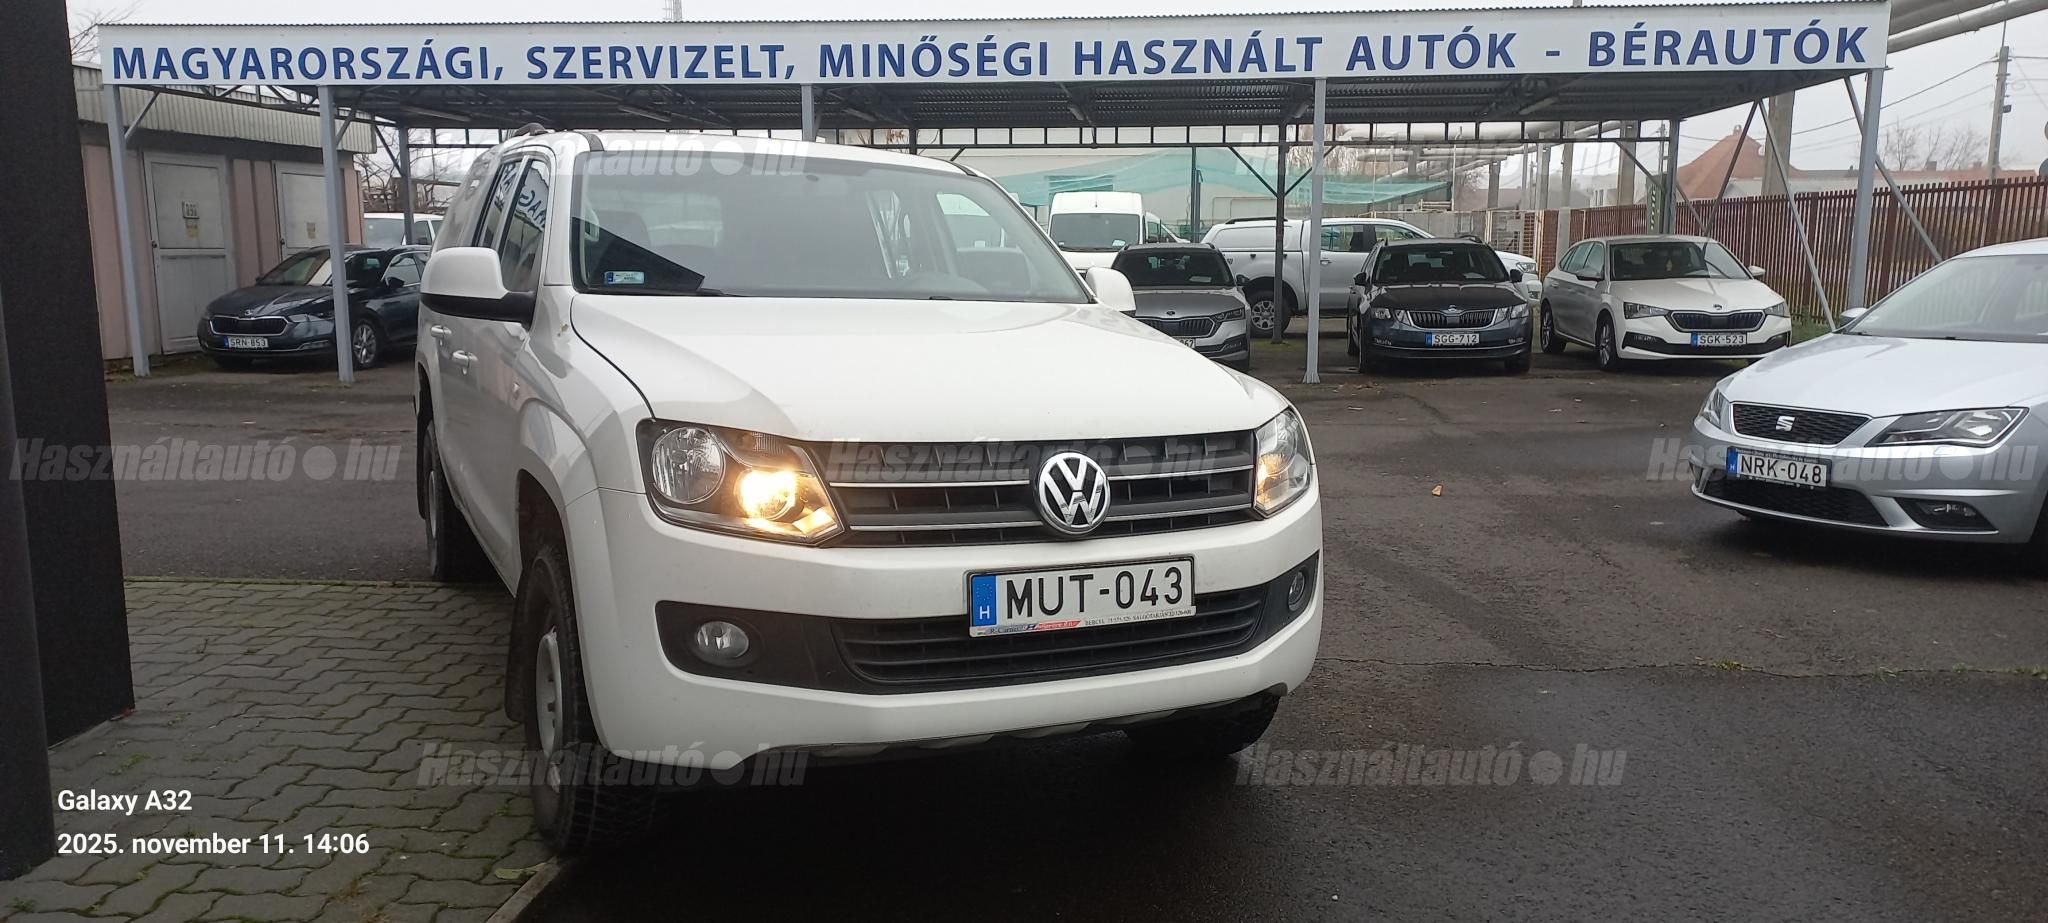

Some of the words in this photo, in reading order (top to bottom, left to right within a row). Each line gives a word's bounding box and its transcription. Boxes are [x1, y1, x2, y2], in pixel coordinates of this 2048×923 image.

[112, 38, 504, 81] MAGYARORSZÁGI,
[526, 43, 795, 81] SZERVIZELT,
[819, 34, 1048, 78] MINŐSÉGI
[1073, 30, 1323, 75] HASZNÁLT
[1345, 25, 1518, 71] AUTÓK
[1588, 19, 1869, 67] BÉRAUTÓK
[1434, 334, 1477, 343] SGG-712
[1699, 335, 1744, 344] SGK-523
[1741, 455, 1822, 483] NRK-048
[979, 605, 990, 620] H
[1006, 566, 1183, 620] MUT-043
